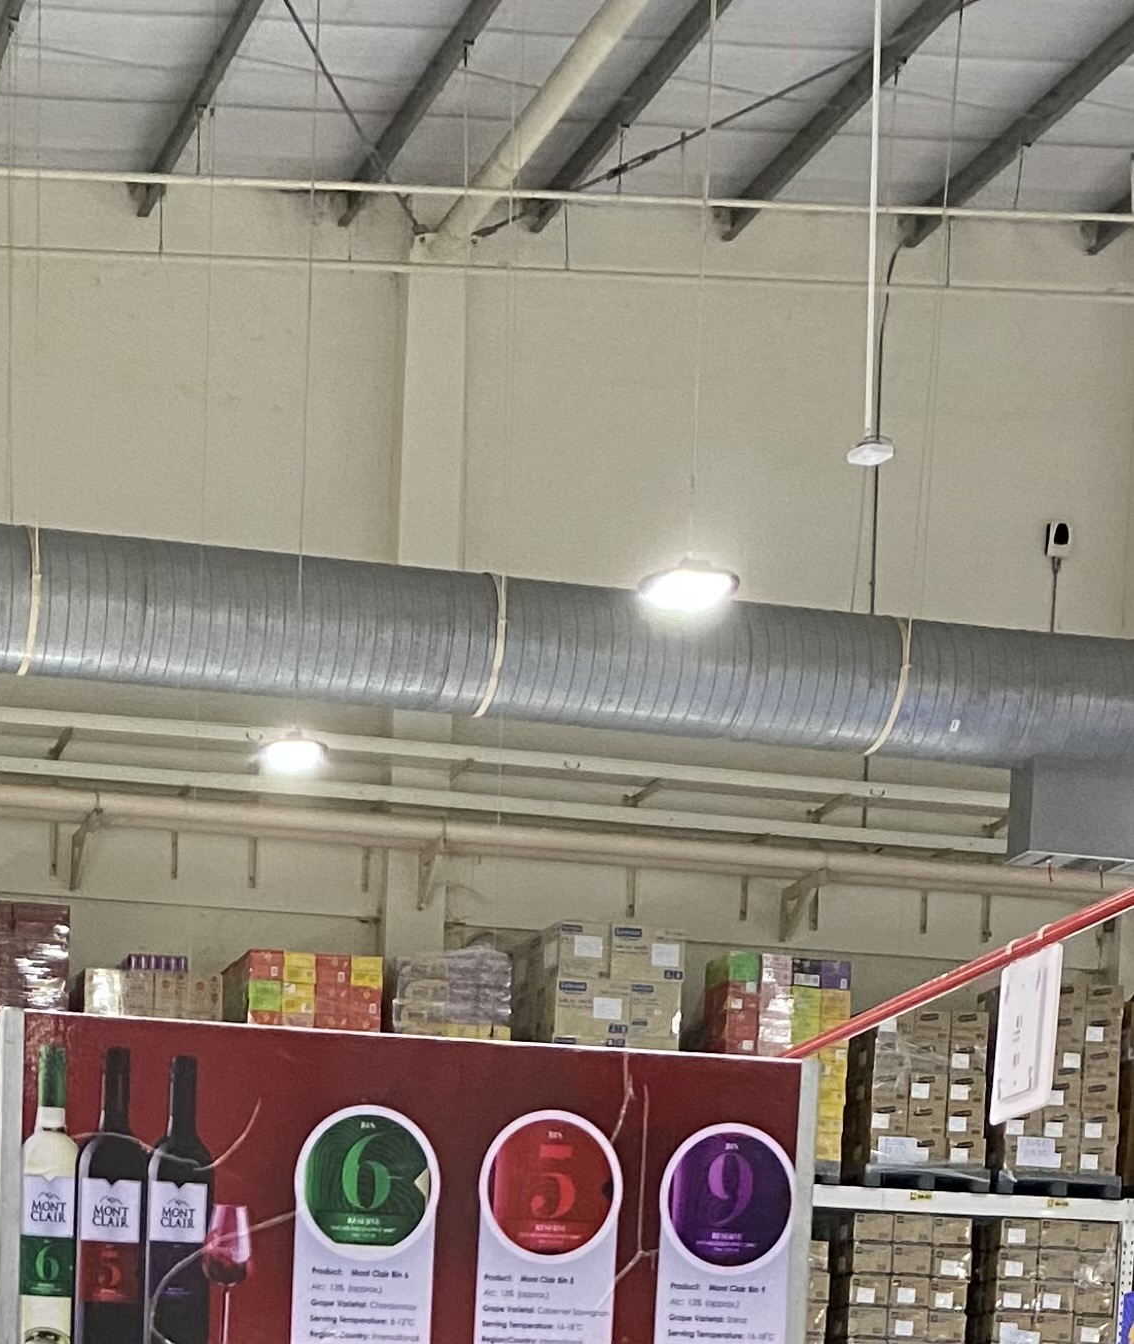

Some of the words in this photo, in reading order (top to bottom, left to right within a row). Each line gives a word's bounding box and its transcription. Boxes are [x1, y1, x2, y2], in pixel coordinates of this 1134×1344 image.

[342, 1133, 391, 1210] 6
[529, 1143, 576, 1218] 5
[708, 1152, 753, 1226] 9
[31, 1201, 66, 1212] MONT
[94, 1205, 129, 1217] MONT
[162, 1207, 195, 1218] MONT
[31, 1212, 66, 1223] CLAIR
[92, 1216, 129, 1228] CLAIR
[160, 1218, 195, 1228] CLAIR
[35, 1244, 59, 1281] 6
